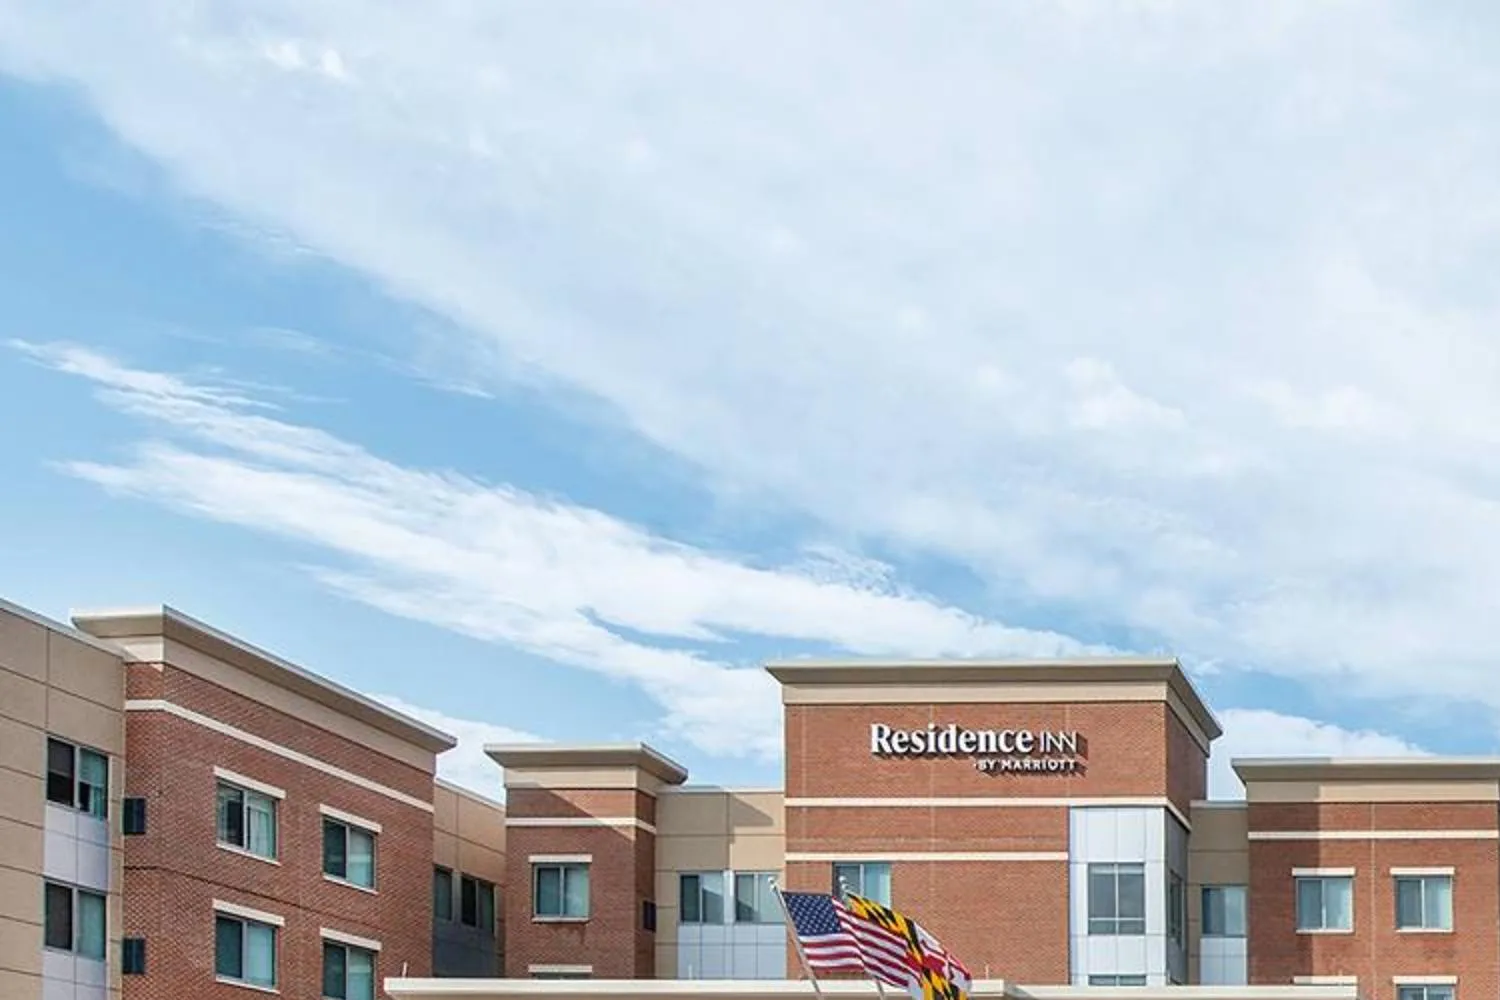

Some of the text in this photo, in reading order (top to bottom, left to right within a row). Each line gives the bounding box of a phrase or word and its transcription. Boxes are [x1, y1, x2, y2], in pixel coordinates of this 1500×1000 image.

[870, 722, 1077, 753] Residence INN
[978, 759, 1076, 771] BY MARRIOTT
